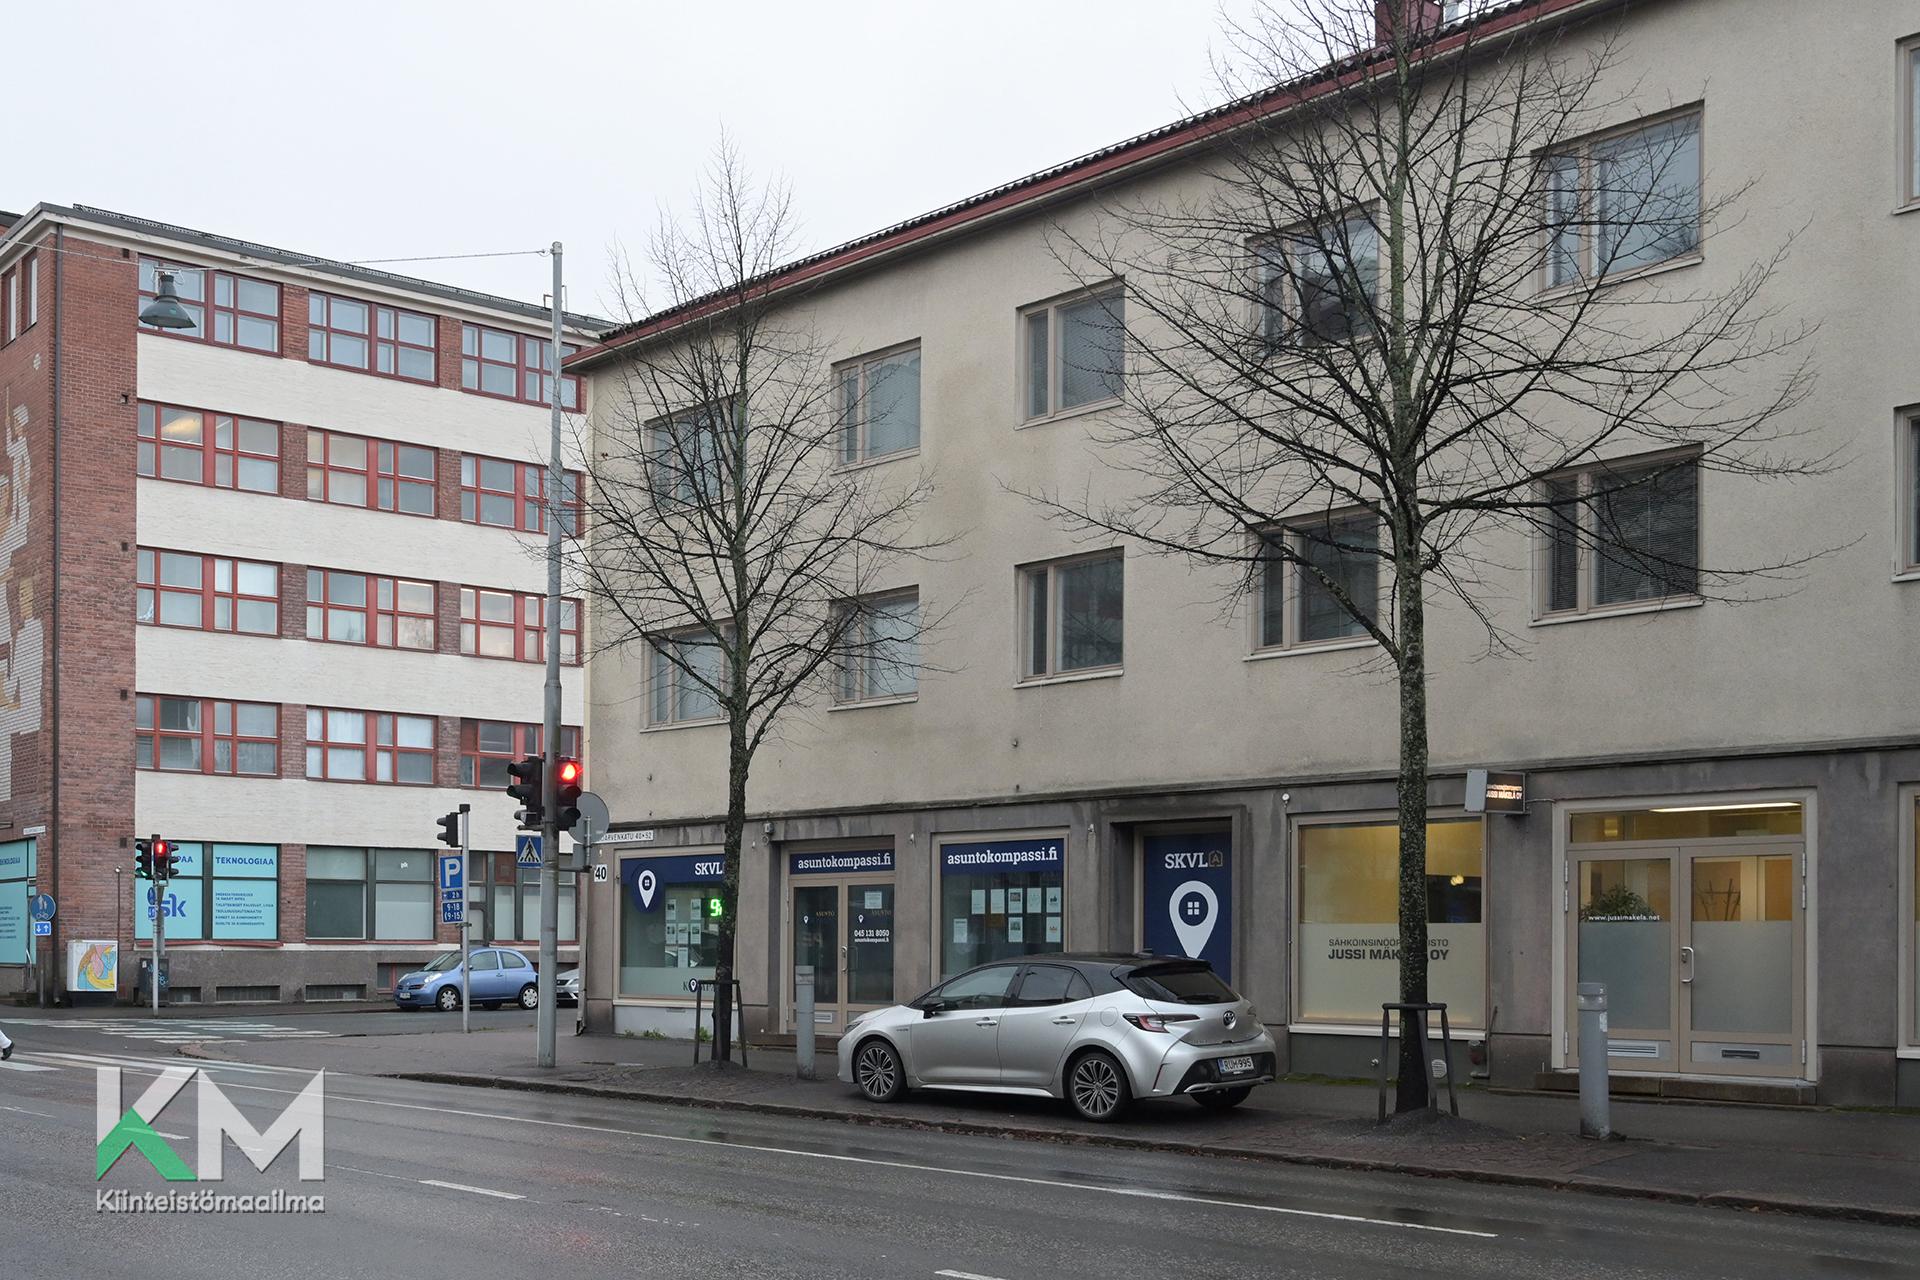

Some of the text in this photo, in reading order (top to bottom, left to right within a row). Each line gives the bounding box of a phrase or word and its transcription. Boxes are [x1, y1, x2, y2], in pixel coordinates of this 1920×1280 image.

[215, 856, 274, 865] TEKNOLOGIAA
[798, 852, 891, 870] asuntokompassi.fi
[947, 846, 1058, 865] asuntokompassi.fi
[1164, 852, 1209, 869] SKVL
[445, 858, 461, 888] P
[595, 867, 606, 880] 40
[694, 861, 723, 875] SKVL
[854, 929, 890, 937] 045 131 8050
[1328, 946, 1449, 961] JUSSI MÄK OY
